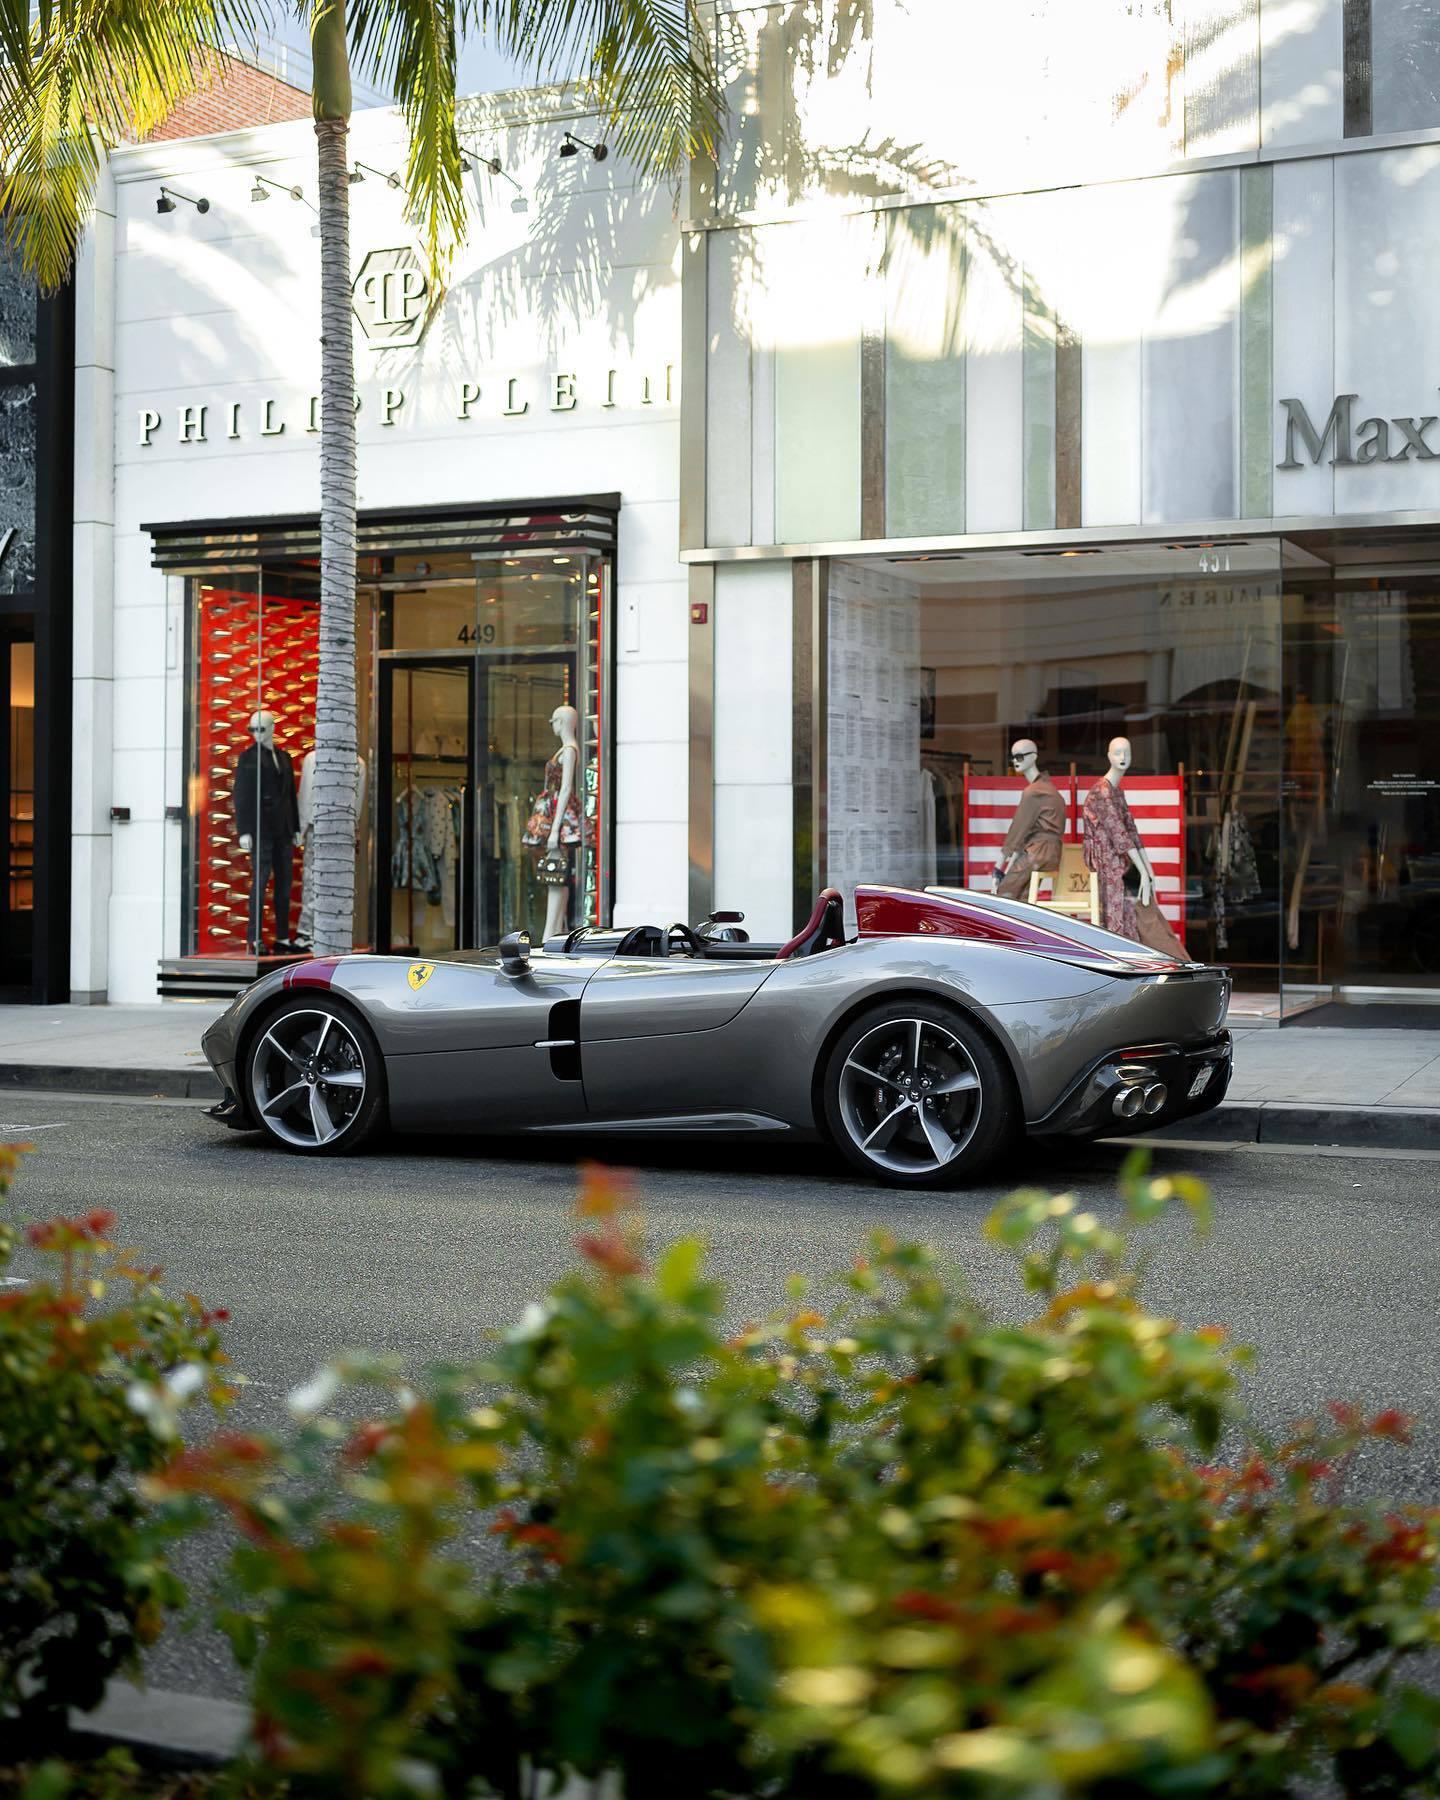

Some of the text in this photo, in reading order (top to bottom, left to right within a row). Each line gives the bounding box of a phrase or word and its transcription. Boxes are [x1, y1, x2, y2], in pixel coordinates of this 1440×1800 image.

[137, 387, 405, 446] PHILIP
[1276, 389, 1440, 469] Max
[457, 623, 496, 645] 449
